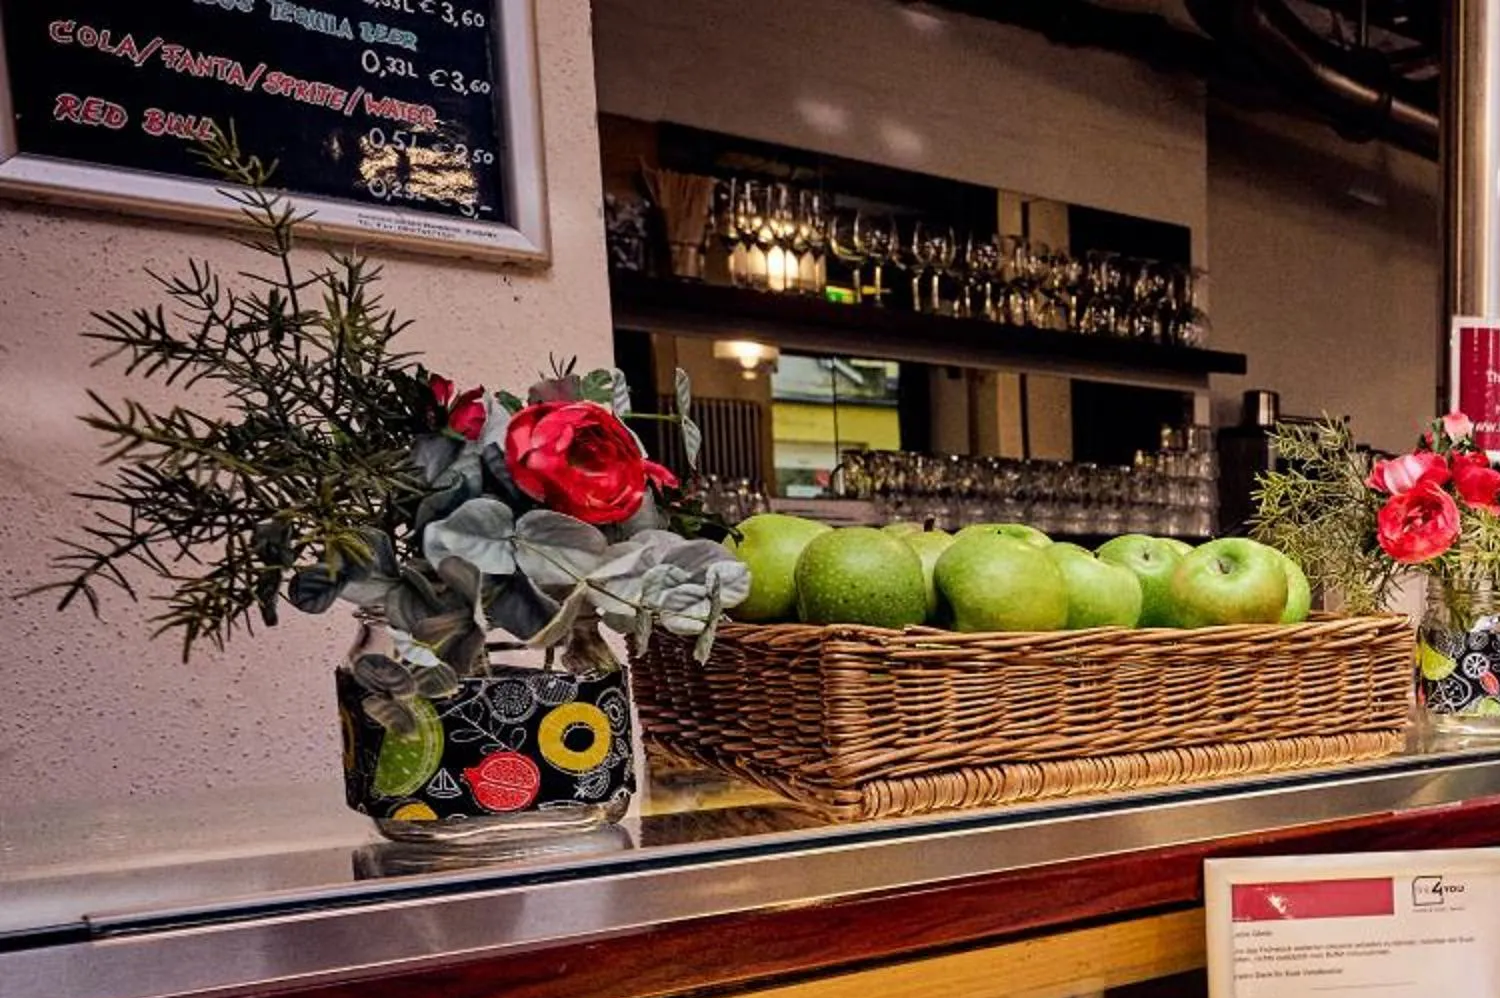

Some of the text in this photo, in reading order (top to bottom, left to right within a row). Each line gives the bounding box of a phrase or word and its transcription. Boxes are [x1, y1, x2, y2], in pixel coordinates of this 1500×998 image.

[358, 21, 418, 51] BEER
[53, 93, 217, 141] RED BULL
